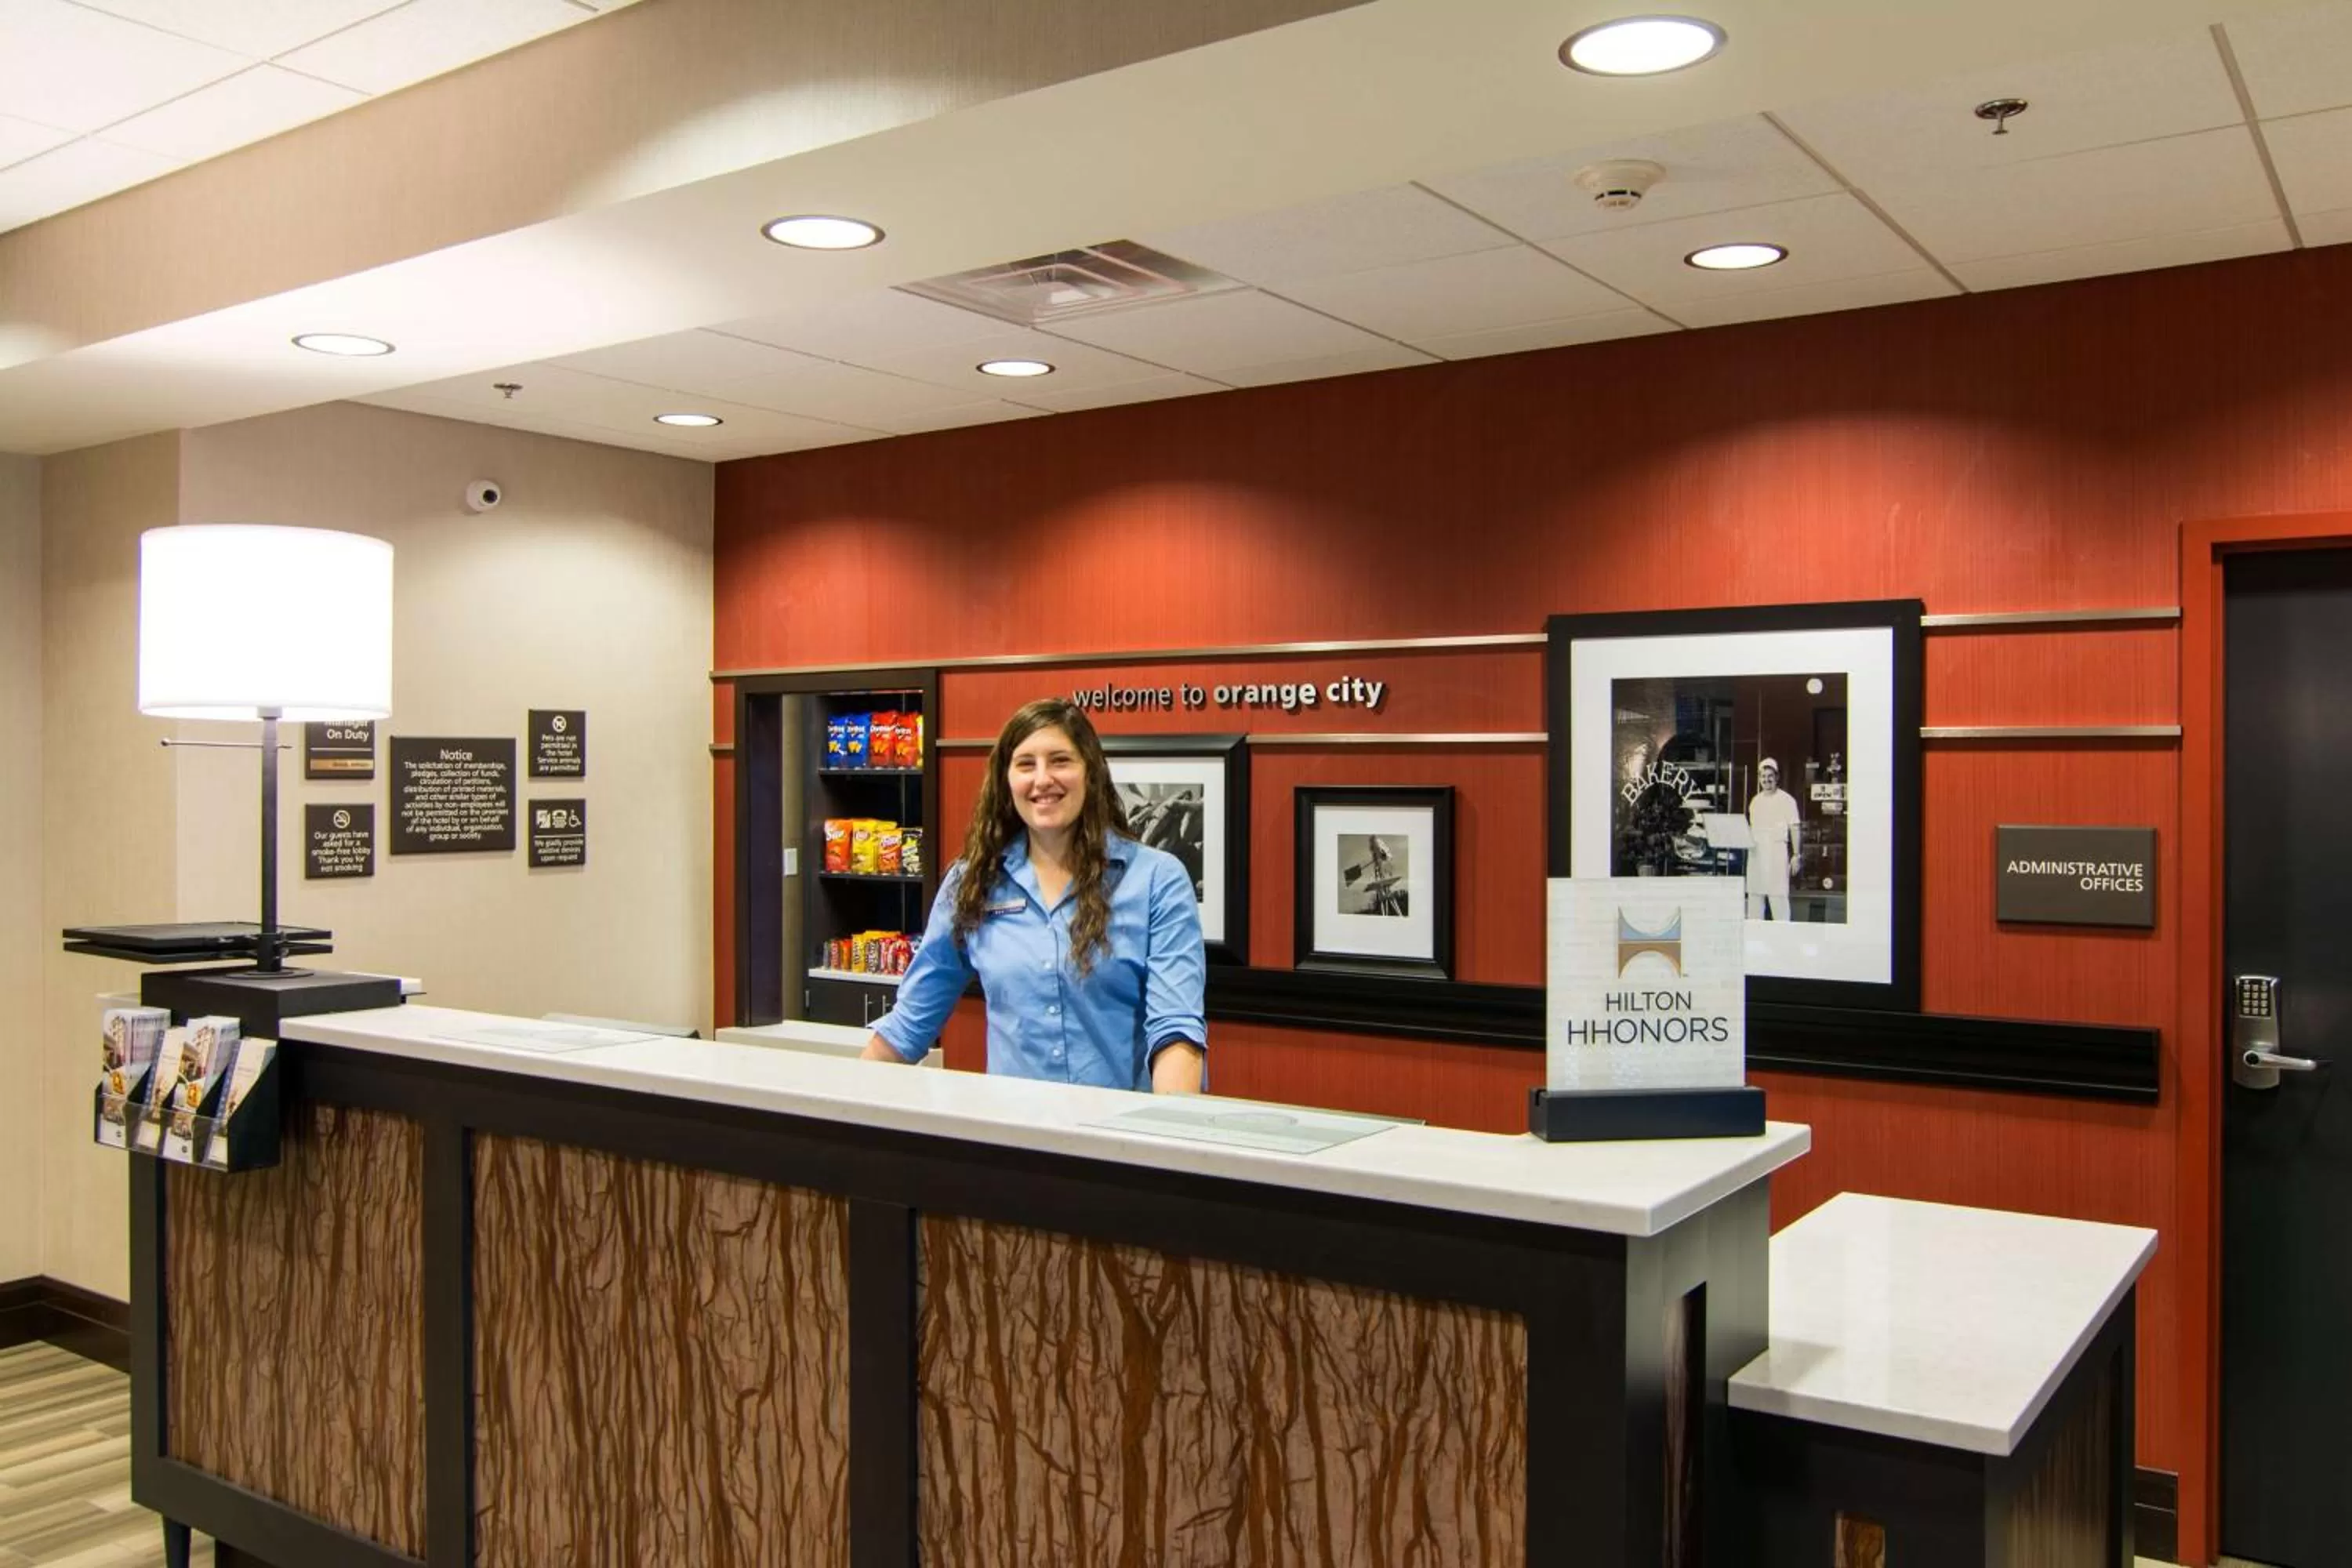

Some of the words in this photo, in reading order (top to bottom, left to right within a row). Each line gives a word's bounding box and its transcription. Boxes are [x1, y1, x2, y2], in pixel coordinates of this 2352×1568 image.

[1073, 684, 1172, 706] welcome
[1180, 684, 1204, 704] to
[1213, 681, 1317, 710] orange
[1326, 676, 1384, 708] city
[327, 728, 343, 739] On
[344, 728, 369, 742] Duty
[439, 749, 473, 761] Notice
[1621, 760, 1703, 806] BAKERY
[451, 816, 460, 826] by
[405, 825, 415, 833] of
[328, 832, 352, 841] guests
[311, 848, 351, 856] smoke-free
[352, 847, 371, 855] lobby
[334, 864, 363, 873] smoking
[2006, 860, 2143, 877] ADMINISTRATIVE
[2080, 877, 2144, 892] OFFICES
[1606, 991, 1692, 1011] HILTON
[1567, 1017, 1730, 1045] HHONORS
